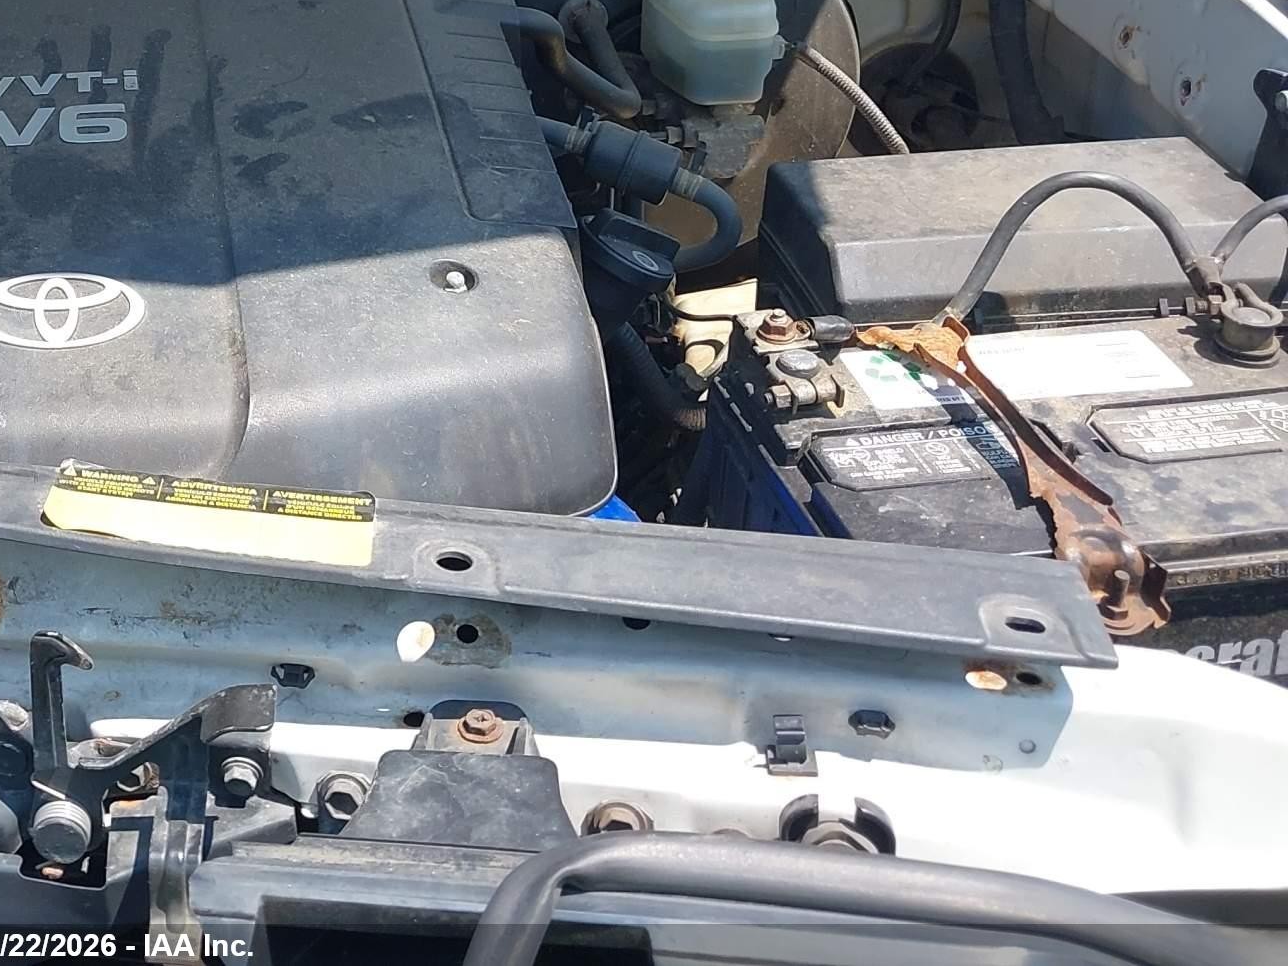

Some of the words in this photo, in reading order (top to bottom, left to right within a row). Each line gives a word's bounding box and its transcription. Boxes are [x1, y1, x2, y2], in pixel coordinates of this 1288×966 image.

[859, 432, 924, 446] DANGER
[81, 470, 139, 482] WARNING
[171, 480, 258, 496] ADVERTENCIA
[272, 490, 373, 507] AVERTISSEMENT
